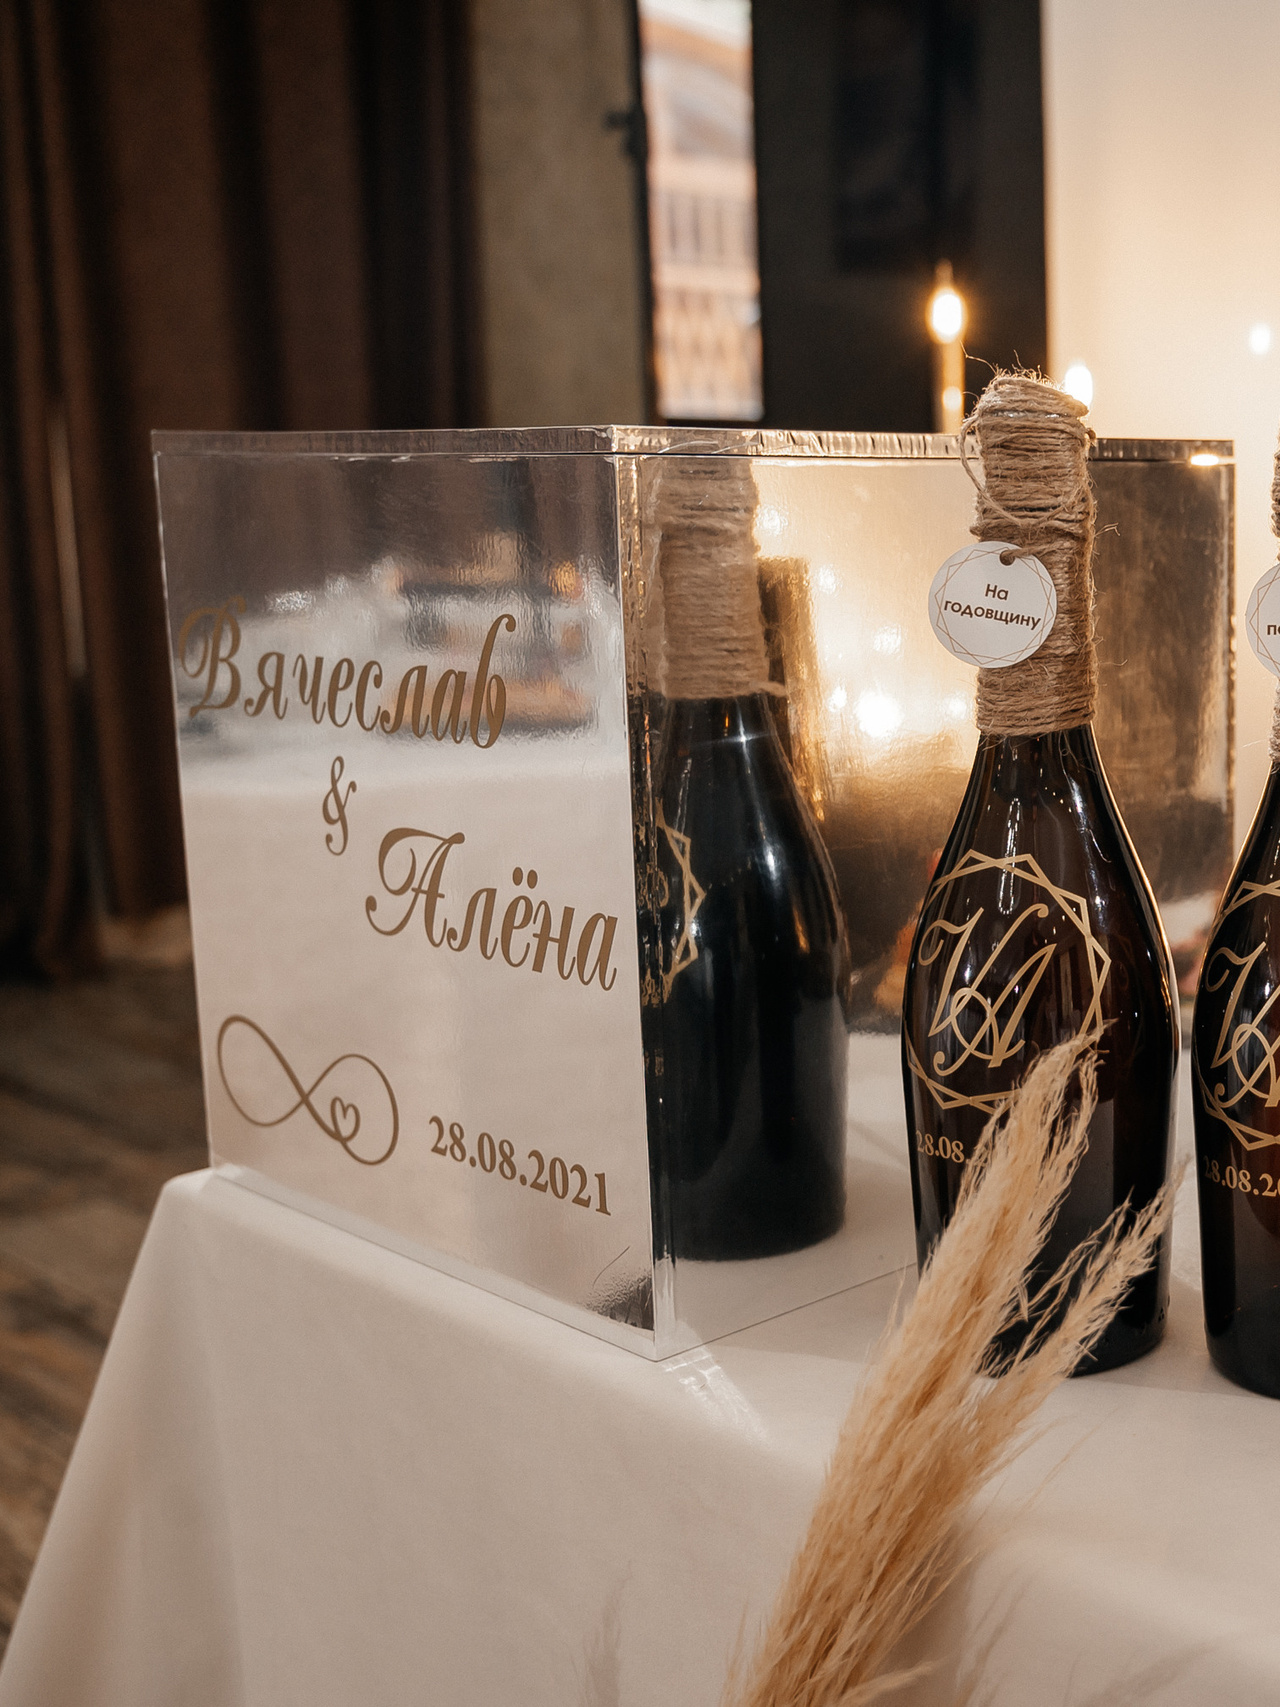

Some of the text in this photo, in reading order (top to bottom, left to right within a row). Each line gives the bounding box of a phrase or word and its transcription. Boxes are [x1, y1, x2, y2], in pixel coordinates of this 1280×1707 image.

[944, 600, 1042, 631] годовщину
[984, 583, 1009, 601] На
[178, 595, 516, 749] Вячеслав
[321, 755, 358, 856] &
[365, 826, 619, 992] Алёна
[428, 1115, 612, 1217] 28.08.2021
